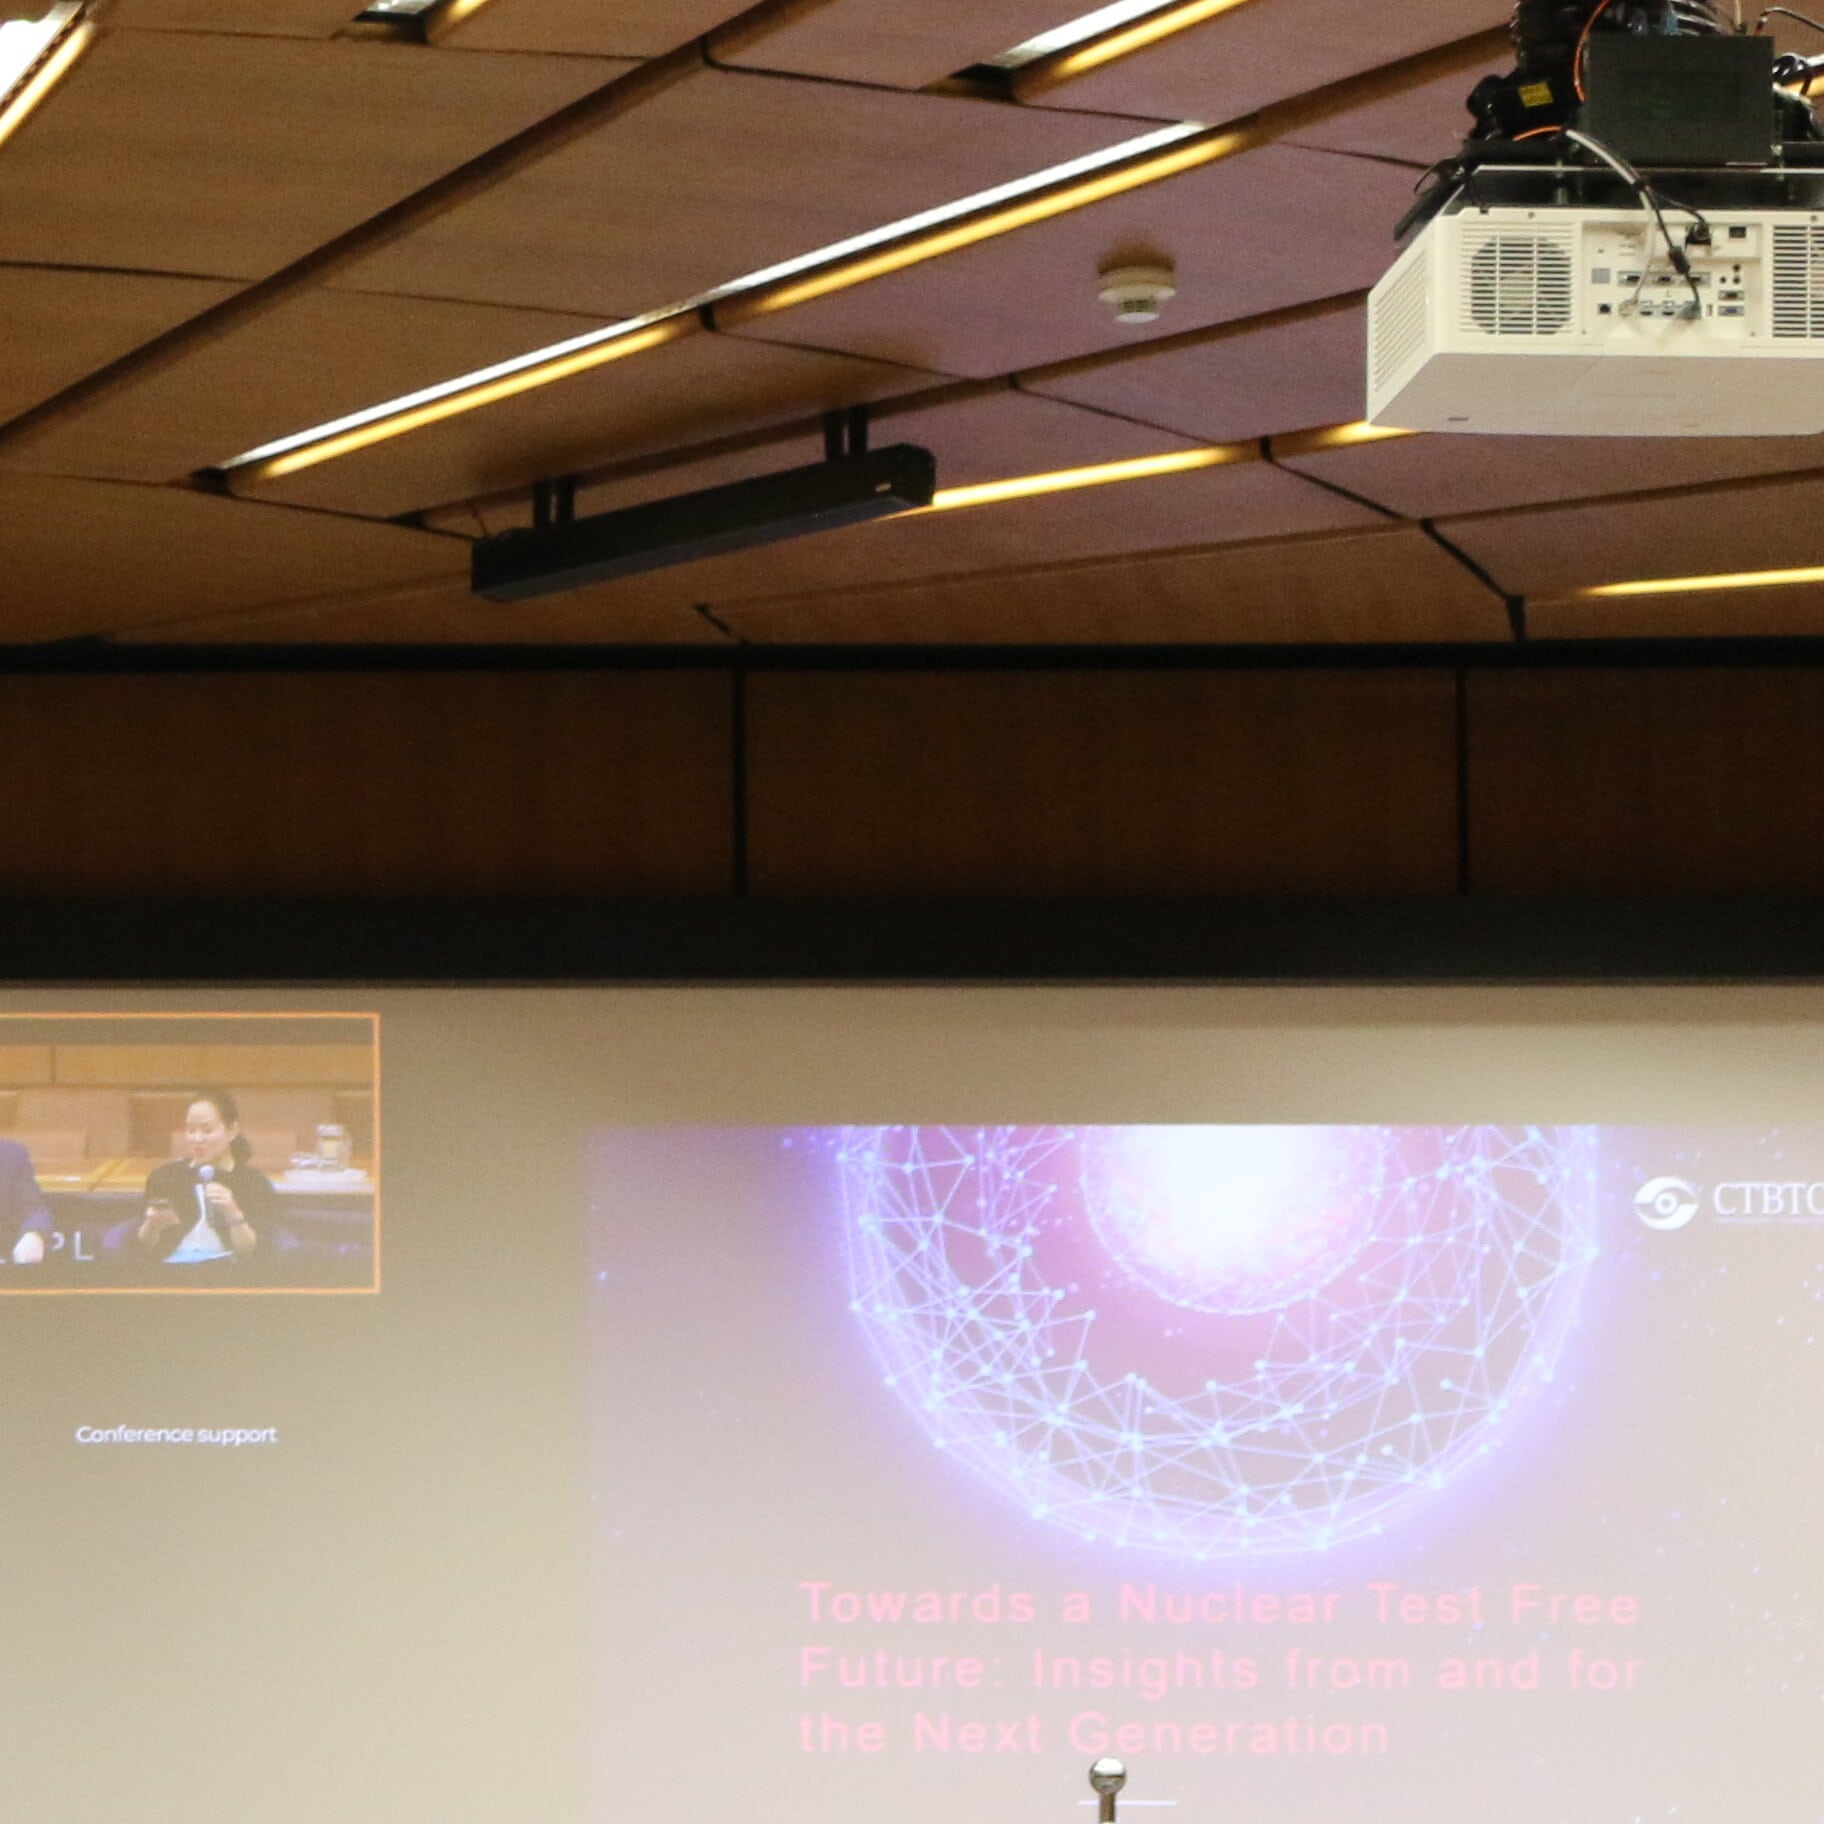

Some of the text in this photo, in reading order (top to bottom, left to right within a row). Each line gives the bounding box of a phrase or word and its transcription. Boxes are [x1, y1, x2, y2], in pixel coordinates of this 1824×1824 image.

[76, 1424, 278, 1447] Conference support
[799, 1581, 1641, 1625] Towards a Nuclear Test Free
[1033, 1646, 1261, 1701] Insights
[1285, 1648, 1412, 1690] from
[1438, 1648, 1542, 1690] and
[1568, 1648, 1650, 1690] for
[799, 1711, 1392, 1755] the Next Generation
